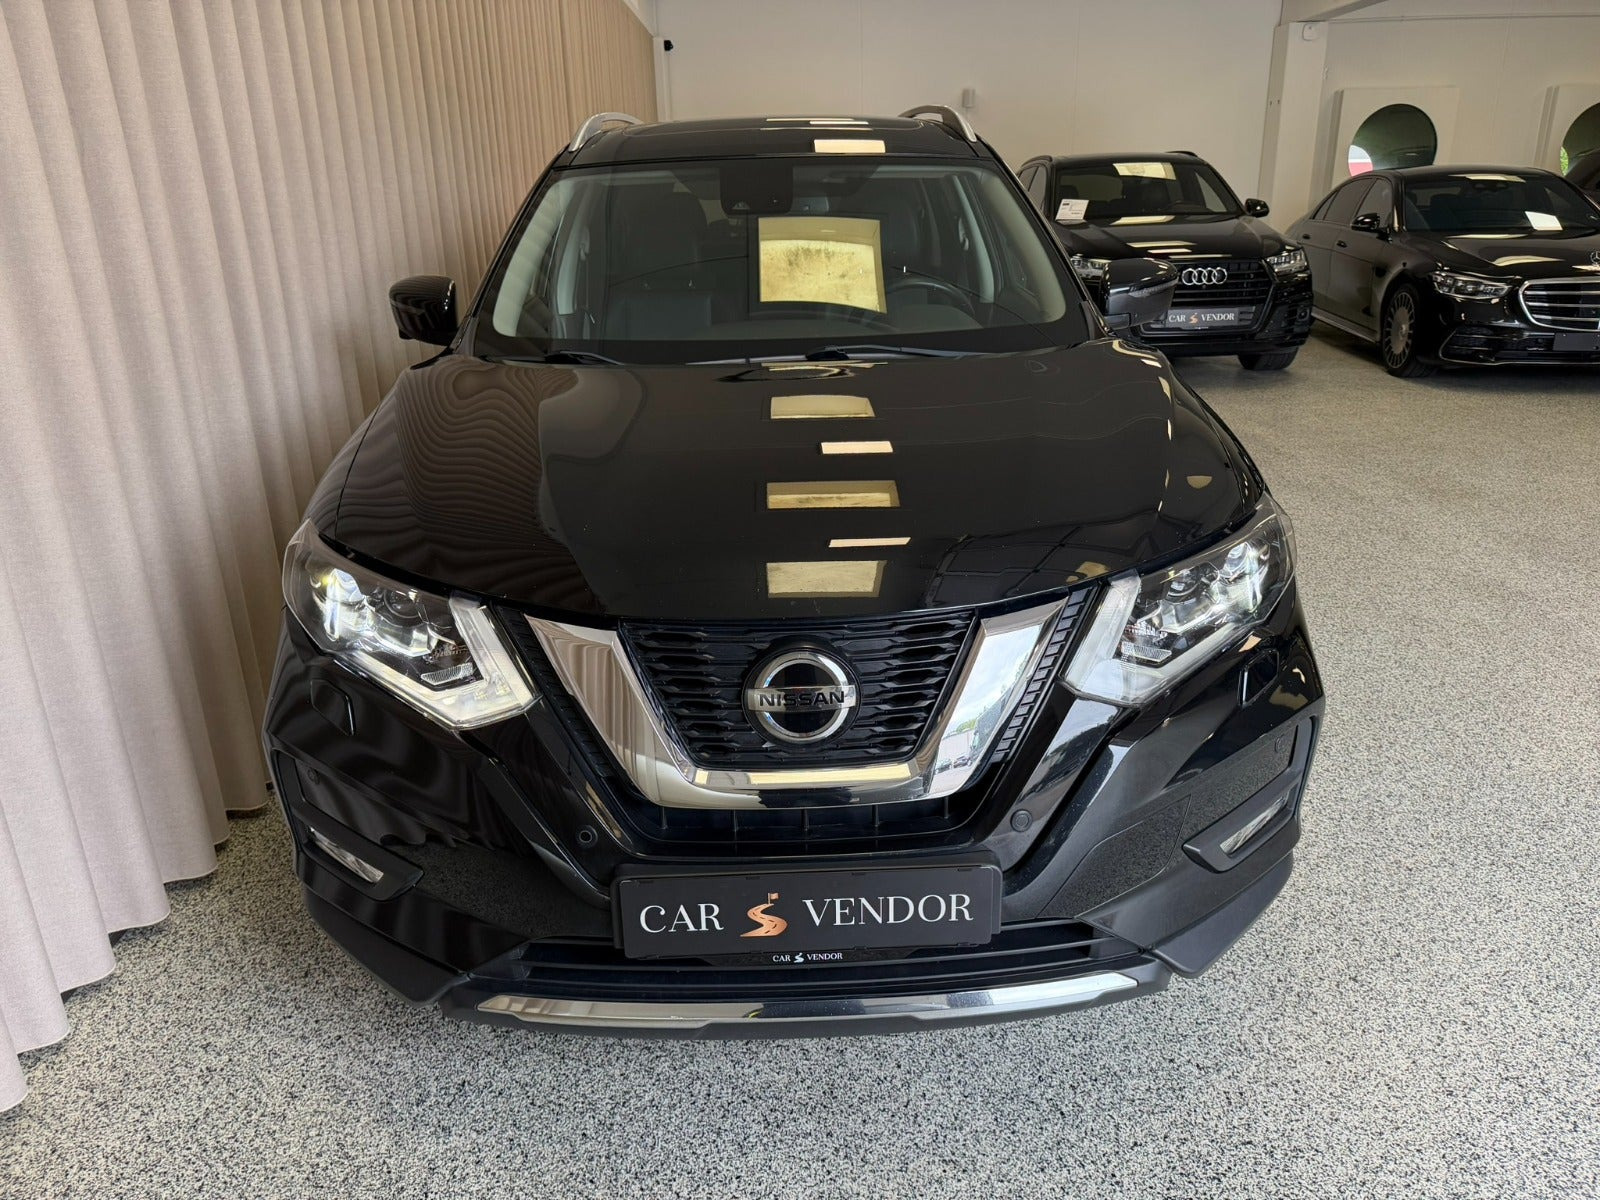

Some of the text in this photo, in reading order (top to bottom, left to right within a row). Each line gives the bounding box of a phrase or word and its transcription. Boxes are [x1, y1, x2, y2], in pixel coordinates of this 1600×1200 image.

[1169, 313, 1235, 323] CAR VENDOR
[760, 691, 844, 707] NISSAN
[639, 893, 973, 933] CAR VENDOR
[772, 952, 843, 962] CAR VENDOR
